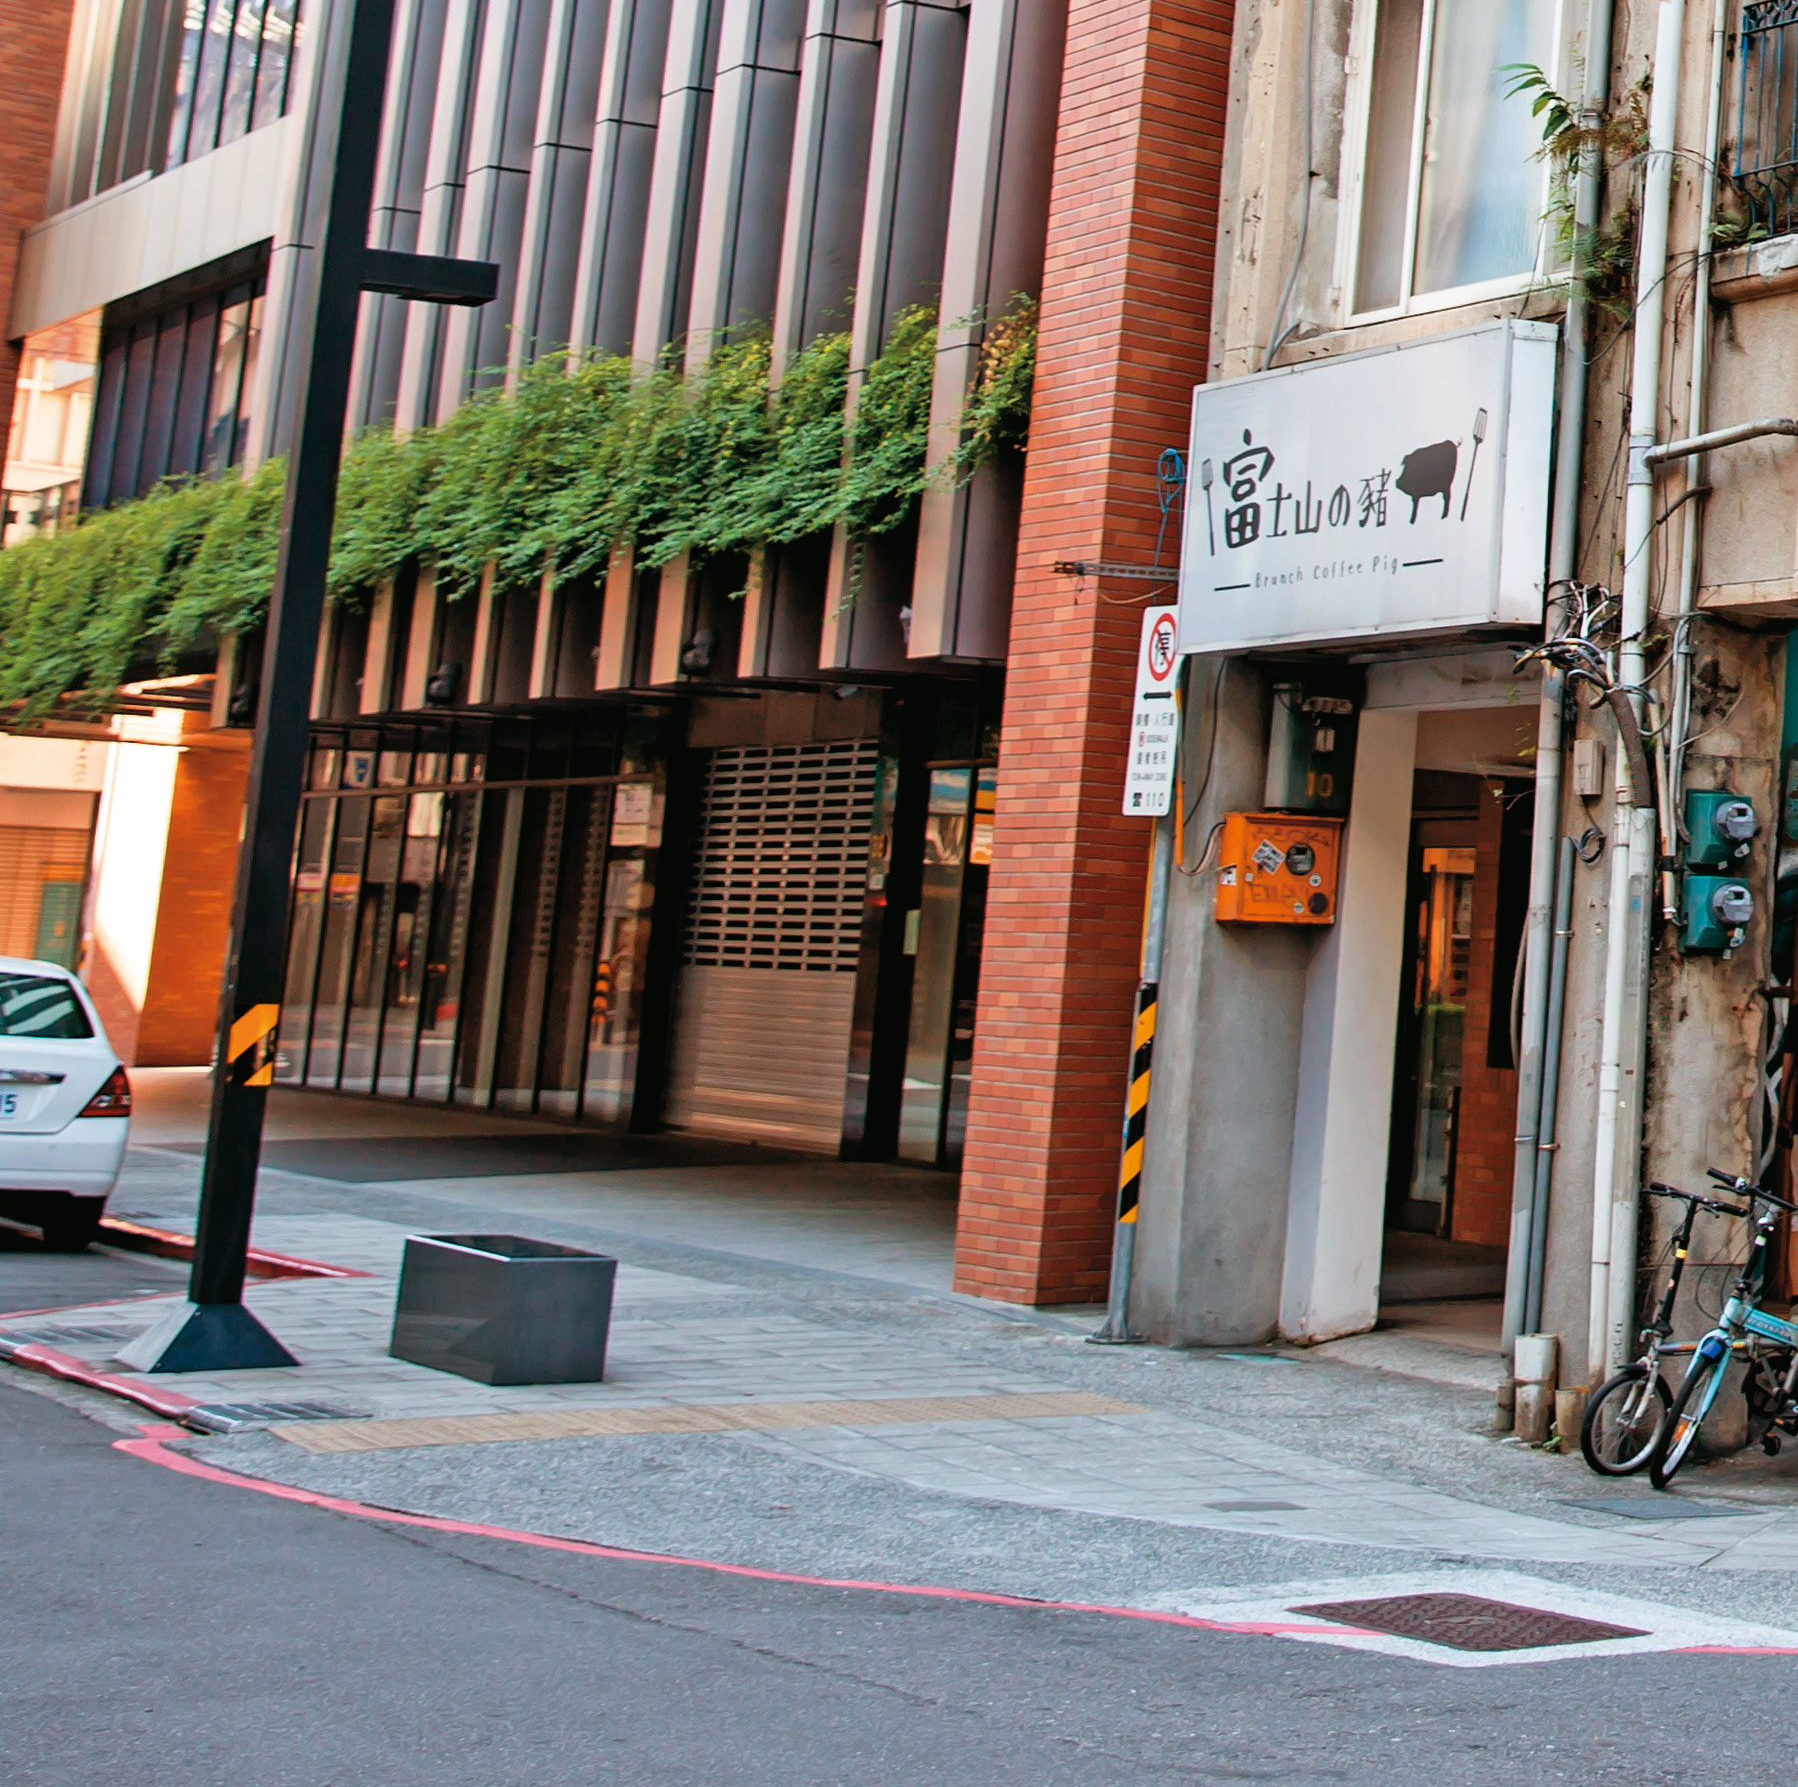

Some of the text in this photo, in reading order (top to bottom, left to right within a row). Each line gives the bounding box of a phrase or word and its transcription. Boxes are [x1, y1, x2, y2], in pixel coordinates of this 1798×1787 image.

[1255, 555, 1399, 588] Brunch Coffee Pig
[1146, 792, 1165, 807] 110
